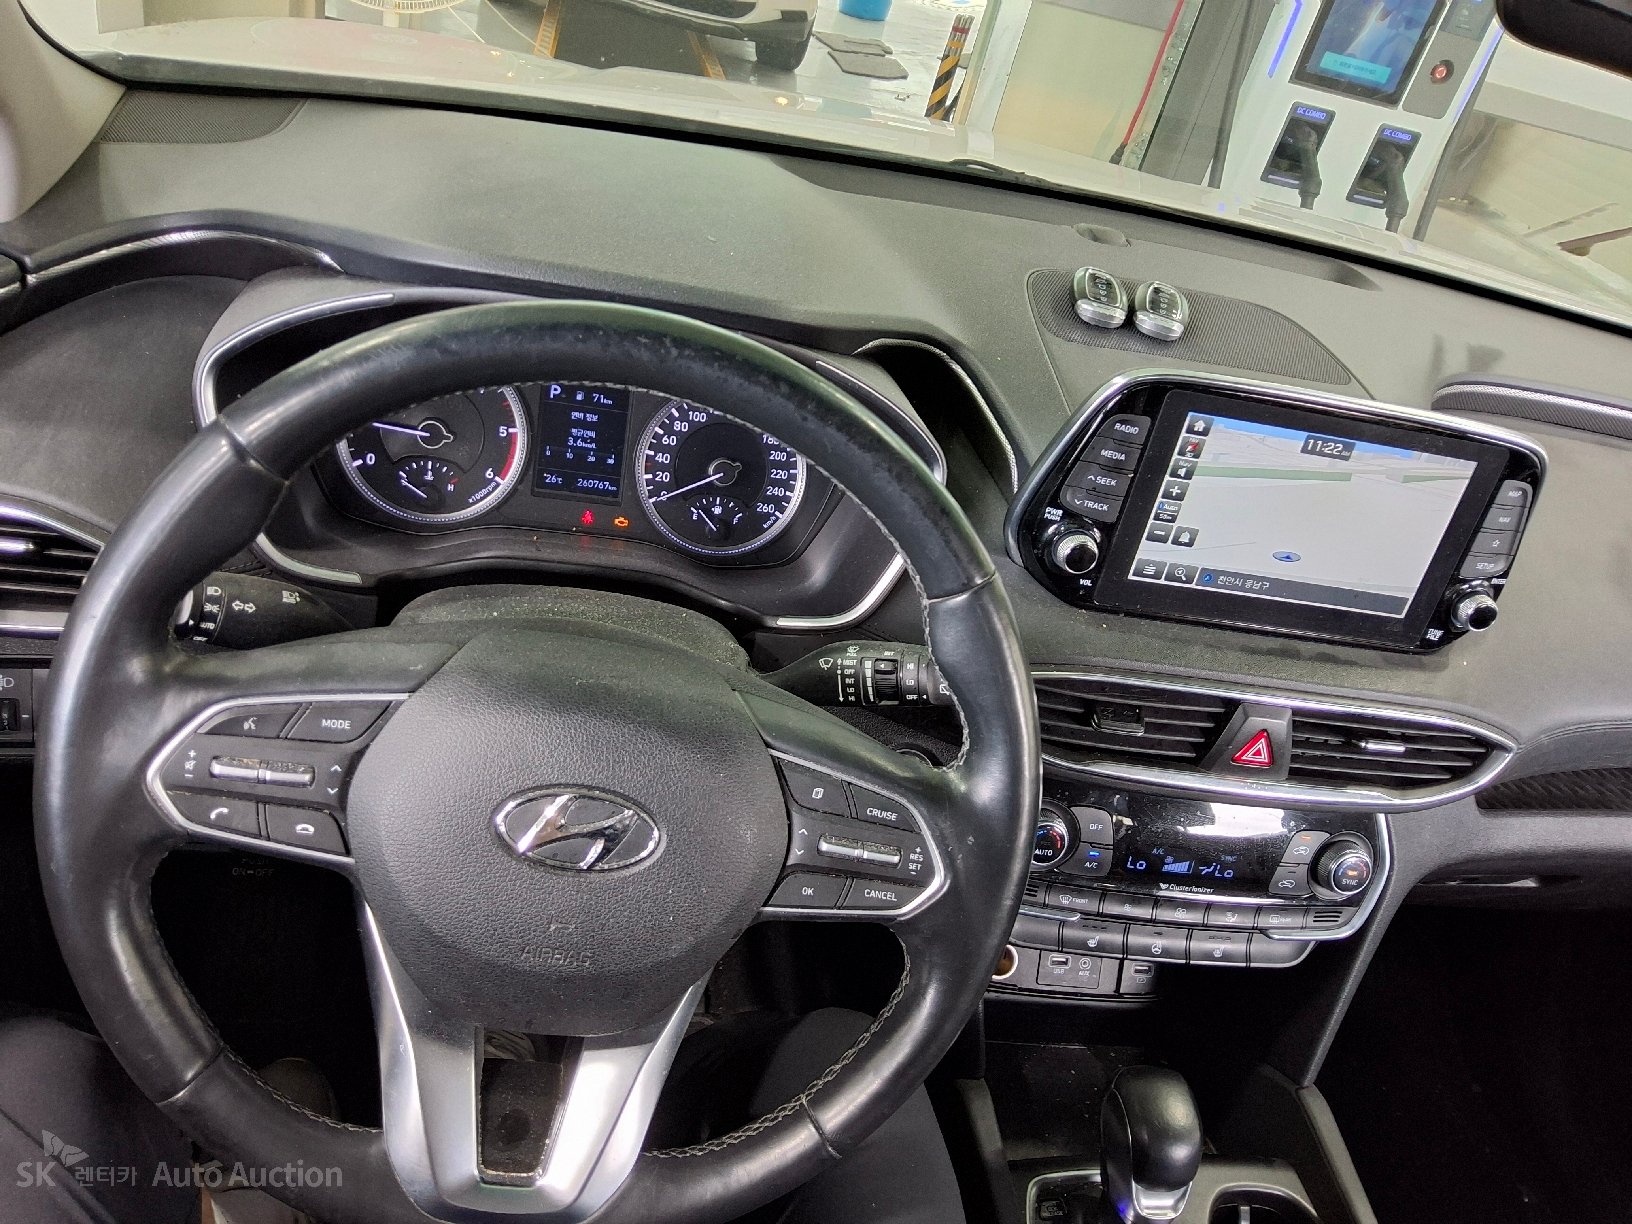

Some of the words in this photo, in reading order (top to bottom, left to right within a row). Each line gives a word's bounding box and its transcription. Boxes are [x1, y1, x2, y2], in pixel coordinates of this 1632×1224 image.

[550, 384, 561, 398] P
[688, 411, 707, 422] 100
[499, 426, 507, 437] 5
[673, 421, 689, 432] 80
[1114, 423, 1140, 435] RADIO
[662, 435, 677, 446] 60
[1307, 439, 1344, 455] 11:22
[366, 453, 376, 465] 0
[655, 453, 670, 464] 40
[769, 451, 787, 461] 200
[1100, 449, 1126, 461] MEDIA
[485, 468, 494, 478] 6
[655, 472, 670, 482] 20
[770, 469, 788, 480] 220
[1096, 476, 1118, 487] SEEK
[766, 487, 785, 497] 240
[757, 503, 775, 513] 260
[1045, 507, 1063, 516] PWR
[1083, 500, 1109, 512] TRACK
[762, 516, 777, 529] km/h
[1079, 578, 1092, 587] VOL
[321, 718, 351, 729] MODE
[866, 807, 898, 821] CRUISE
[909, 853, 924, 862] RES
[1034, 848, 1053, 856] AUTO
[908, 862, 922, 871] SET
[1084, 861, 1098, 869] A/C
[1342, 878, 1359, 886] SYNC
[802, 886, 814, 896] OK
[864, 889, 898, 901] CANCEL
